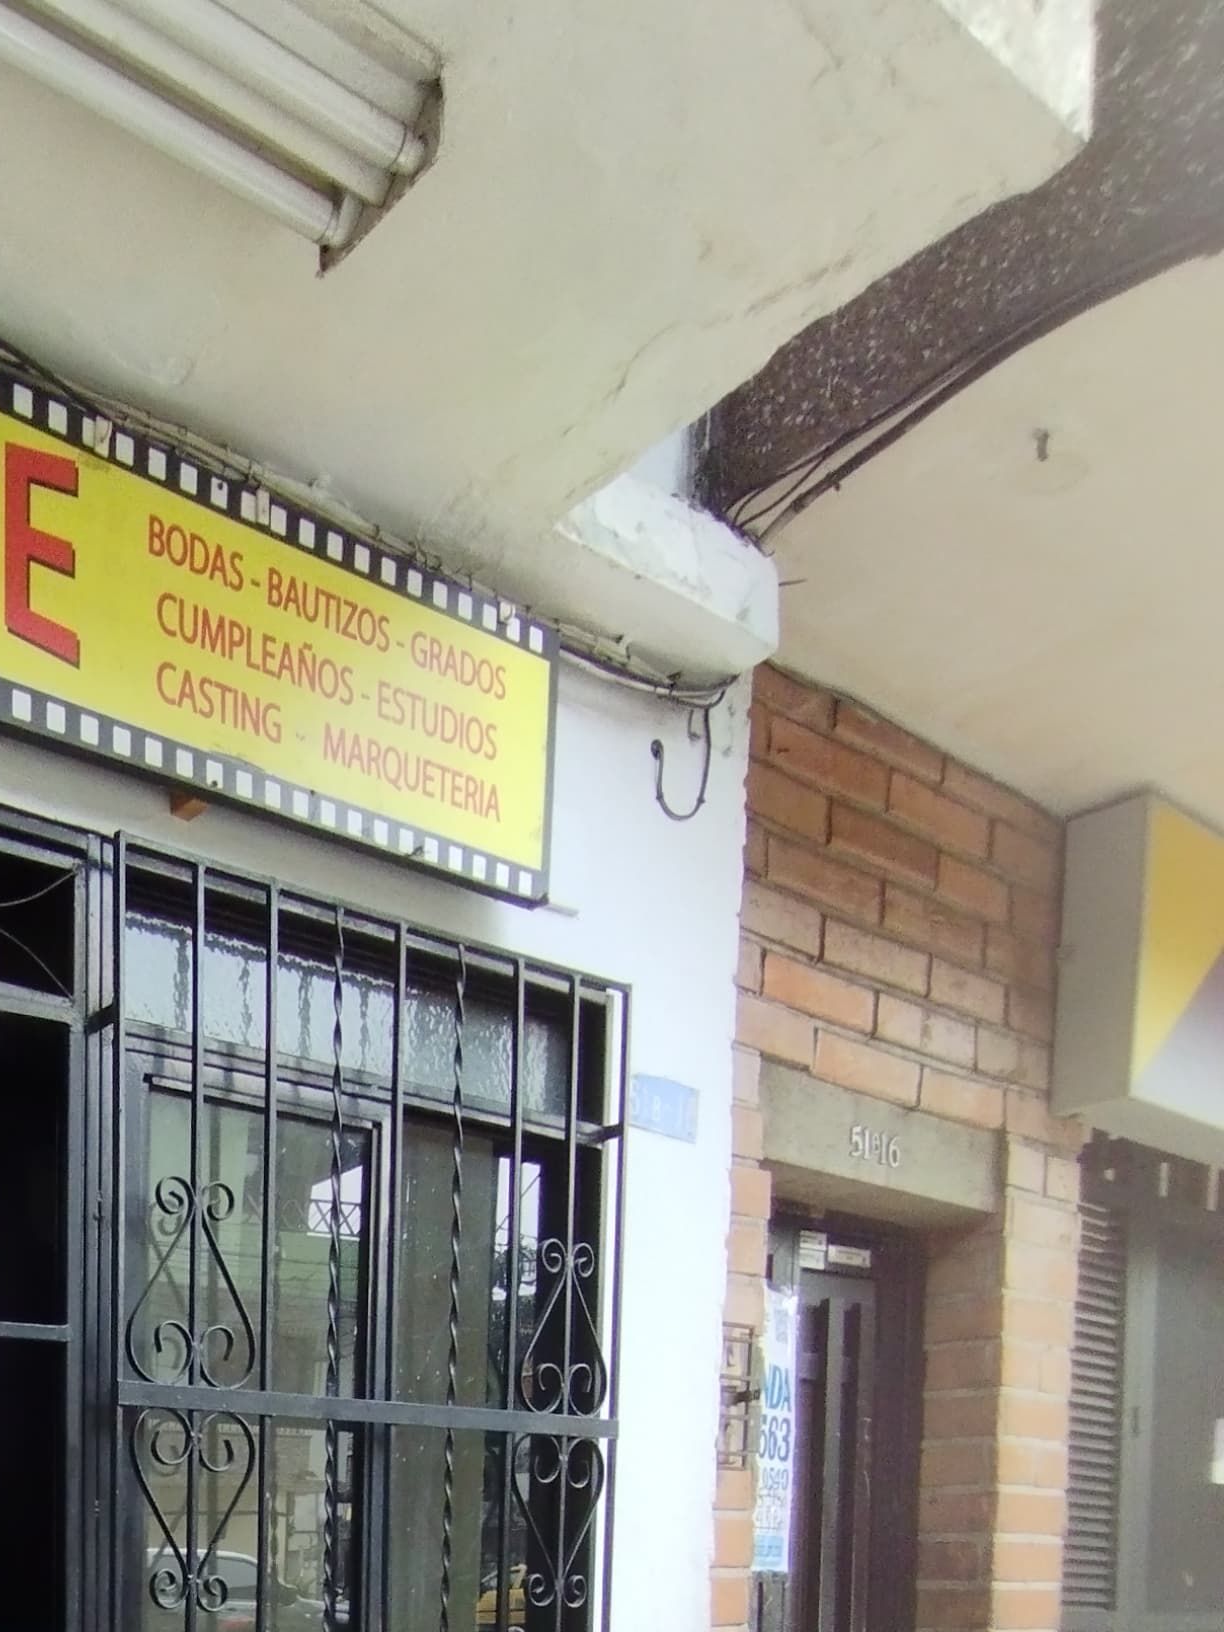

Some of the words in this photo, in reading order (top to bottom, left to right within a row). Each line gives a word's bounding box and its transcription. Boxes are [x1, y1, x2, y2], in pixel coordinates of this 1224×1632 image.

[148, 514, 243, 592] BODAS
[267, 567, 390, 653] BAUTIZOS
[410, 630, 507, 700] GRADOS
[156, 592, 354, 706] CUMPLEAÑOS
[377, 680, 498, 761] ESTUDIOS
[156, 662, 282, 744] CASTING
[323, 722, 501, 823] MARQUETERIA
